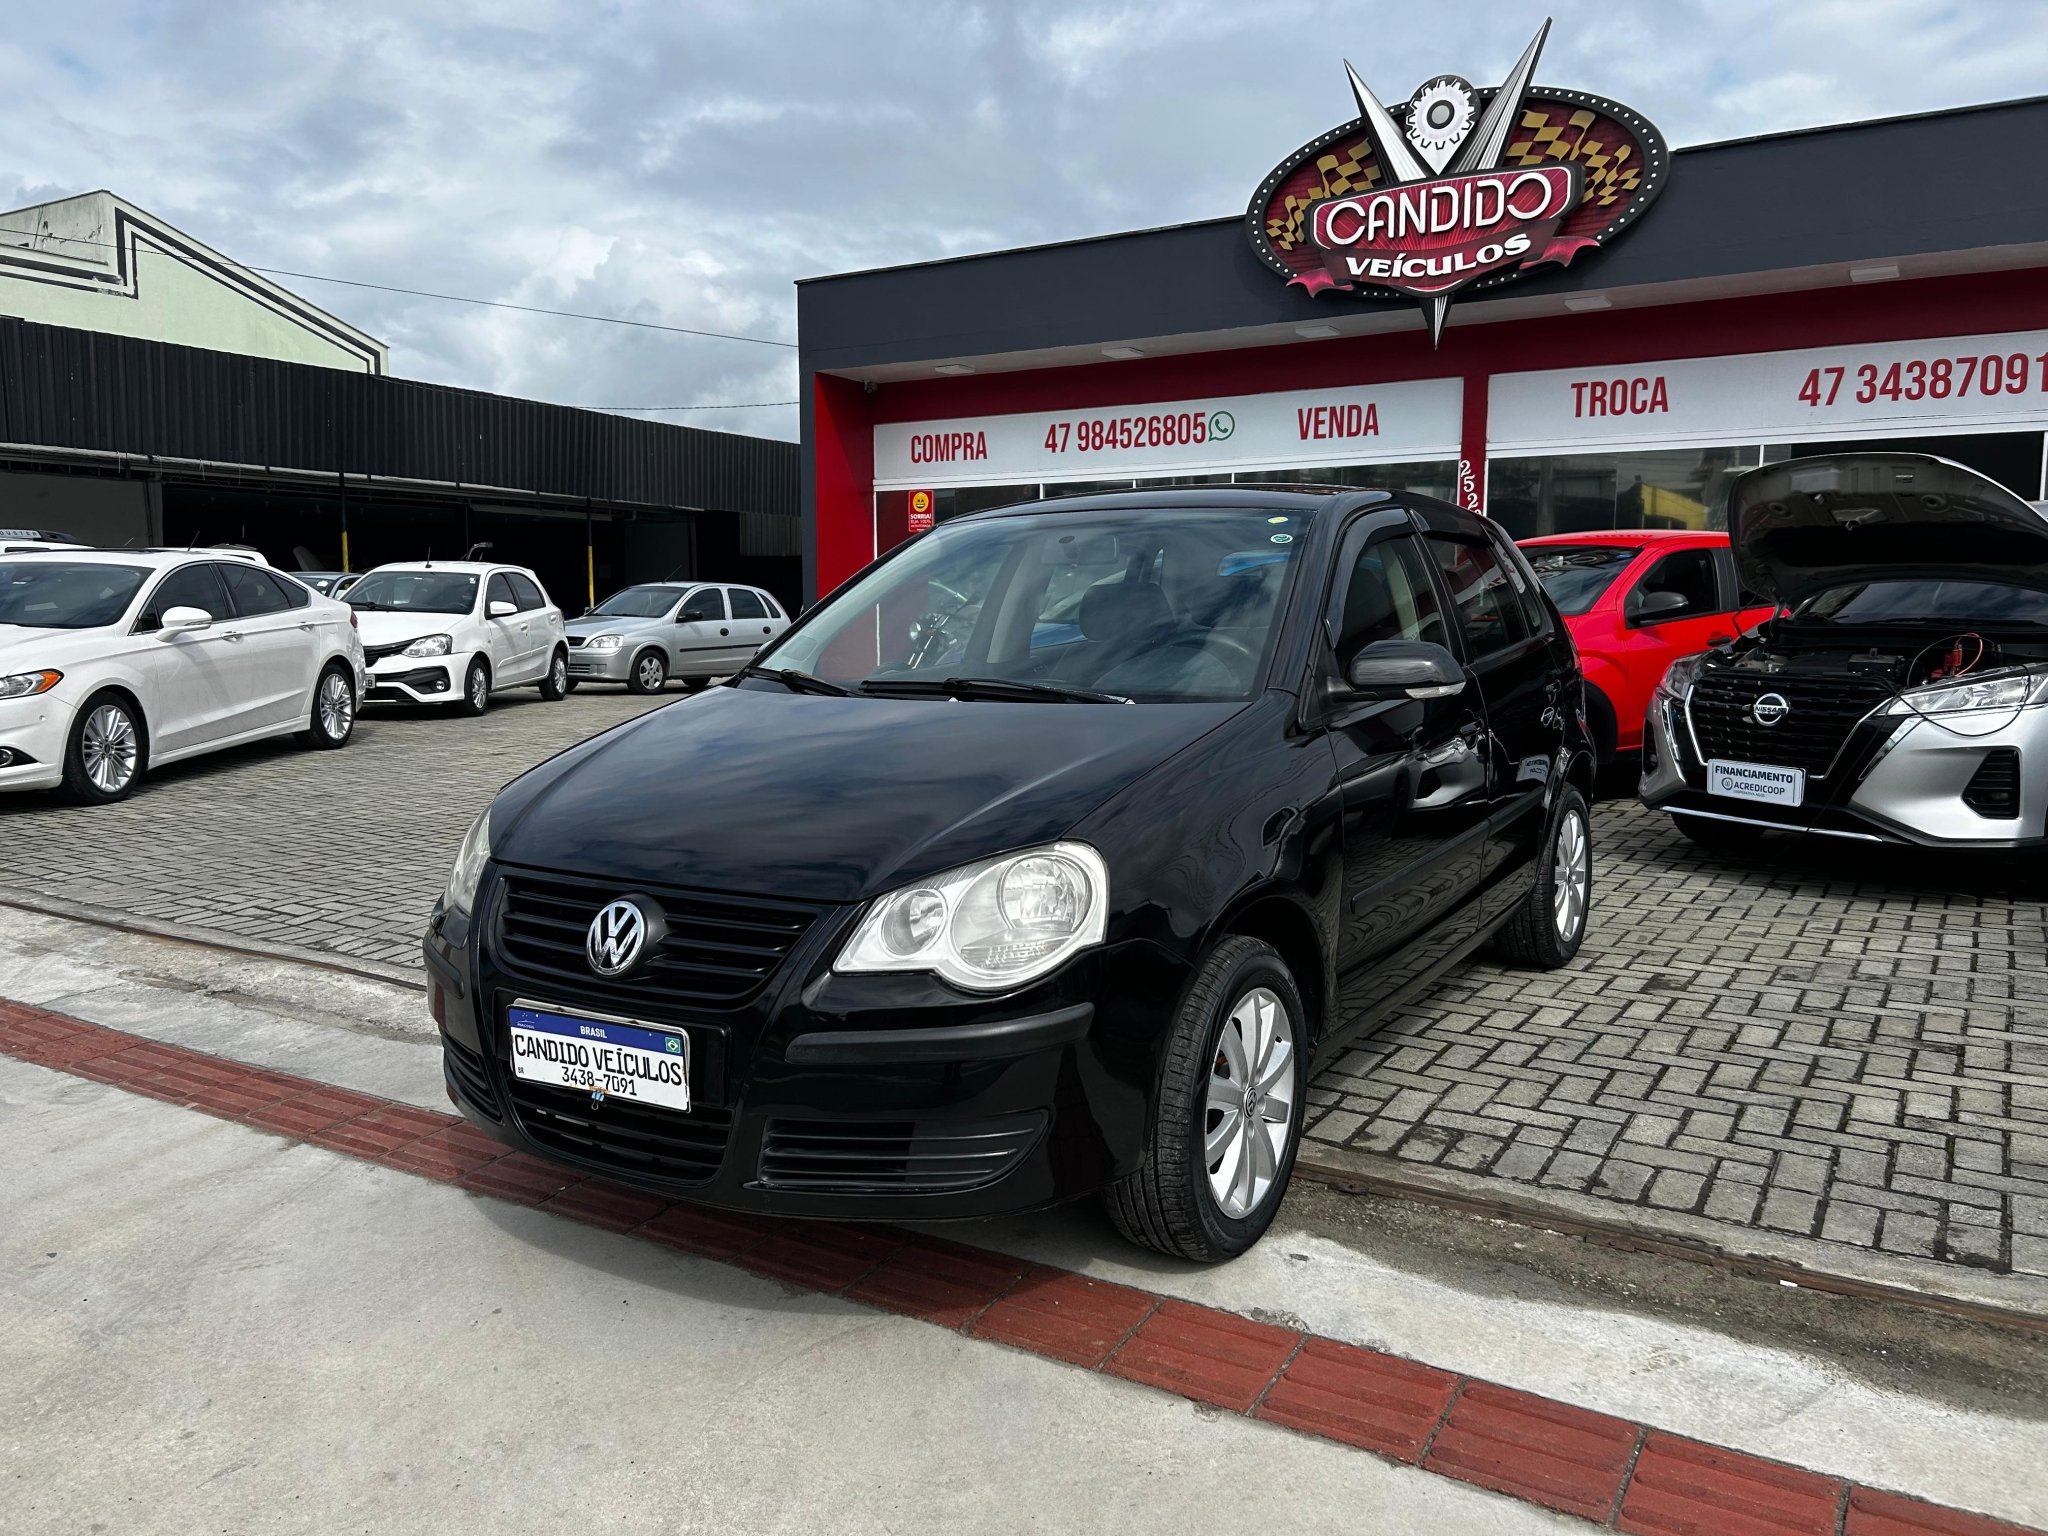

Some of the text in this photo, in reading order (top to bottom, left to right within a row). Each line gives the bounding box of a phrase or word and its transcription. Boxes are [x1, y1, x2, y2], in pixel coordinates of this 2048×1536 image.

[1325, 172, 1552, 246] CANDIDO
[1345, 233, 1532, 278] VEÍCULOS
[1571, 376, 1669, 418] TROCA
[1798, 351, 2048, 407] 47 34387091
[1044, 412, 1207, 453] 47 984526805
[1297, 403, 1379, 441] VENDA
[910, 431, 988, 463] COMPRA
[1715, 765, 1793, 784] FINANCIAMENTO
[1733, 781, 1785, 796] ACREDICOOP
[580, 1025, 607, 1039] BRASIL
[514, 1034, 682, 1086] CANDIDO VEÍCULOS
[561, 1066, 637, 1096] 3438-7091
